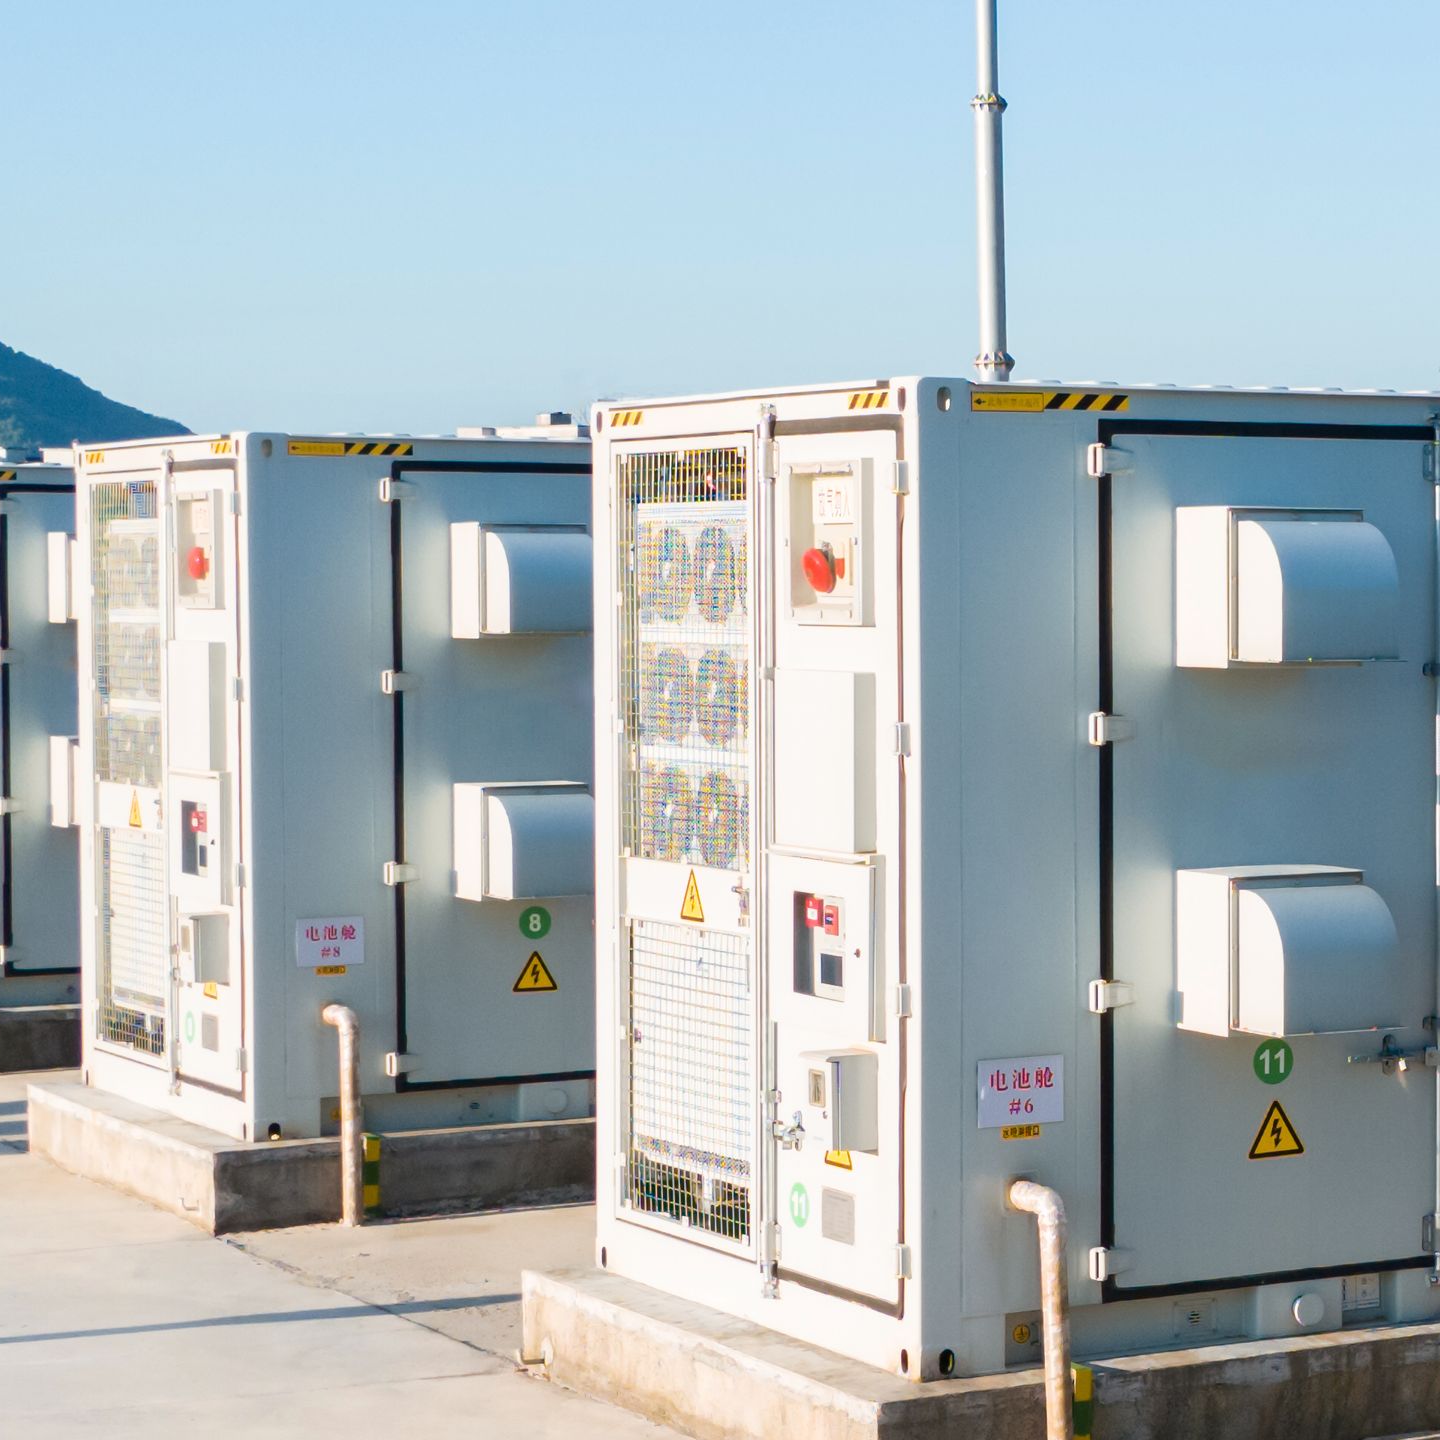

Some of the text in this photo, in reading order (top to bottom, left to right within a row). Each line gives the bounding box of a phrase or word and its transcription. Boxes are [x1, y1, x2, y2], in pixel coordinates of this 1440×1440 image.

[529, 913, 542, 932] 8
[320, 946, 341, 958] #8
[1259, 1048, 1286, 1075] 11
[990, 1066, 1054, 1092] 电池舱
[1009, 1098, 1034, 1115] #6
[791, 1190, 807, 1219] 11
